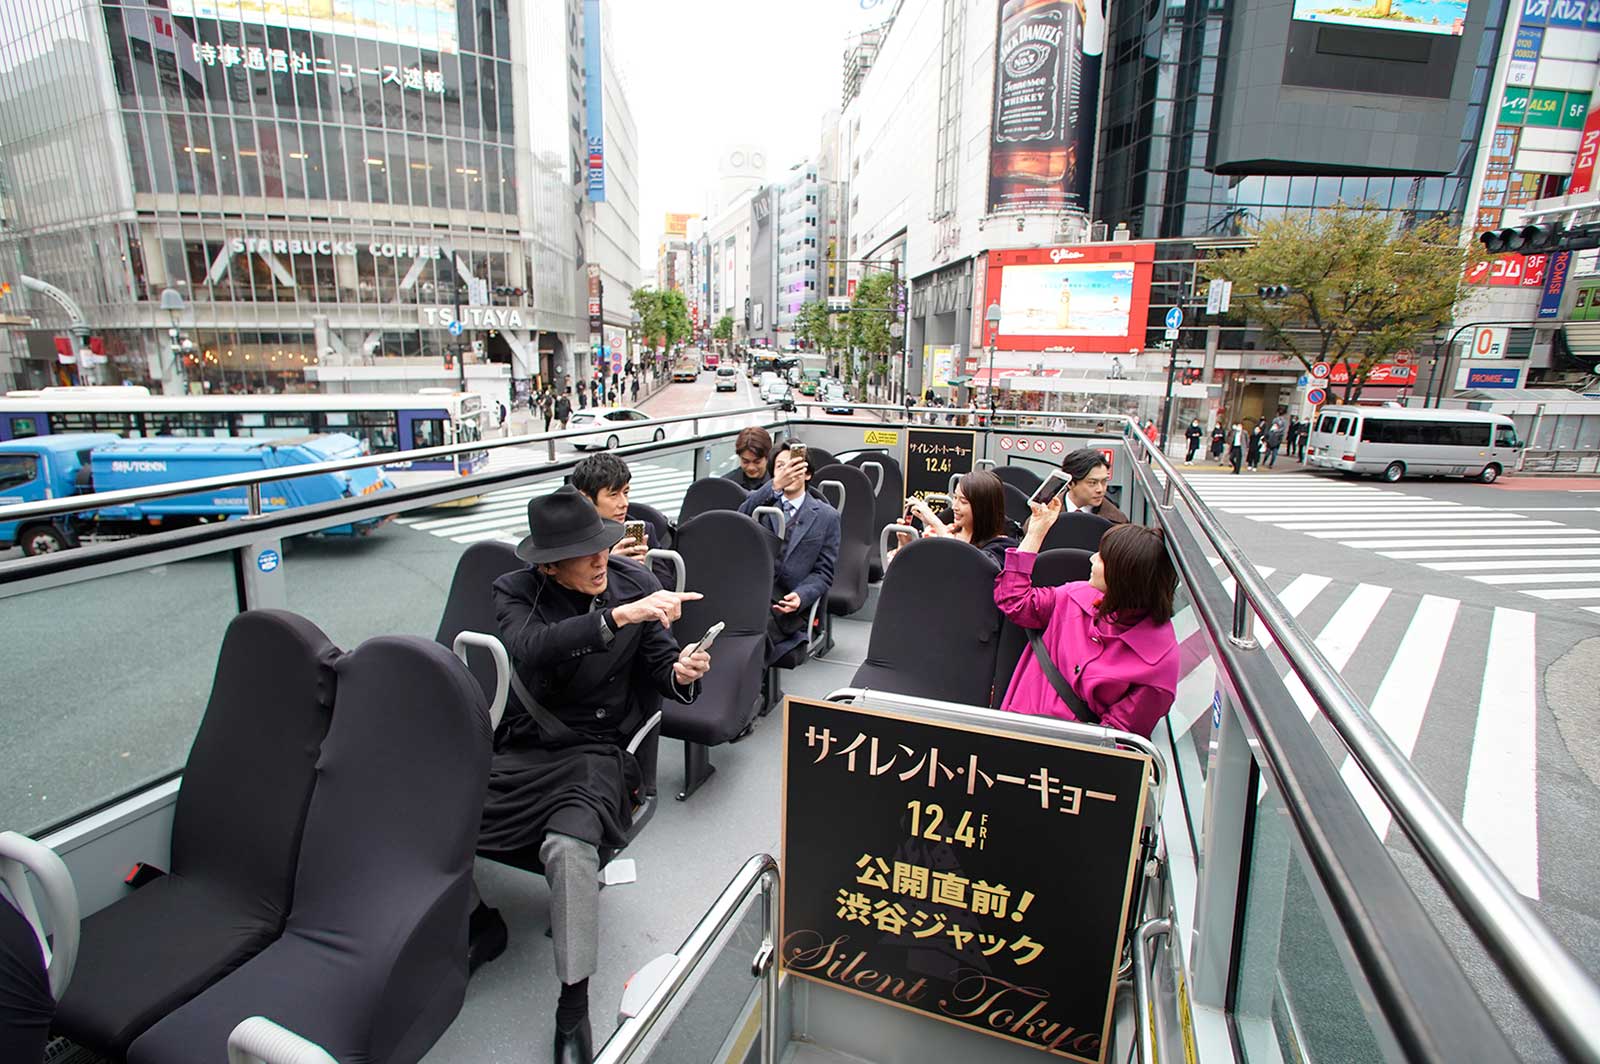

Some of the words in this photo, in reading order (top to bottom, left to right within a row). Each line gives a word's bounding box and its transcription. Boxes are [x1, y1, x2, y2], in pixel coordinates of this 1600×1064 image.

[1020, 24, 1063, 47] DANIEL'S
[192, 42, 445, 93] 時事通信社ニュース速報
[1003, 77, 1047, 94] Tennessee
[1003, 92, 1045, 107] WHISKEY
[1502, 96, 1528, 109] レイク
[1529, 99, 1558, 112] ALSA
[1569, 104, 1585, 118] 5F
[1578, 129, 1600, 169] アコム
[232, 237, 358, 258] STARBUCKS
[369, 242, 442, 260] COFFEE
[1471, 259, 1521, 278] アコム
[1527, 255, 1545, 268] 3F
[424, 308, 522, 327] TSUTAYA
[1471, 374, 1503, 383] PROMISE
[925, 457, 948, 472] 12.4
[804, 725, 1117, 815] サイレント・トーキョー
[907, 799, 976, 849] 12.4
[979, 813, 988, 851] FRI
[855, 852, 1035, 923] 公開直前！
[835, 888, 1045, 966] 渋谷ジャック
[782, 929, 929, 1001] Silent
[939, 966, 1101, 1052] Tokyo
